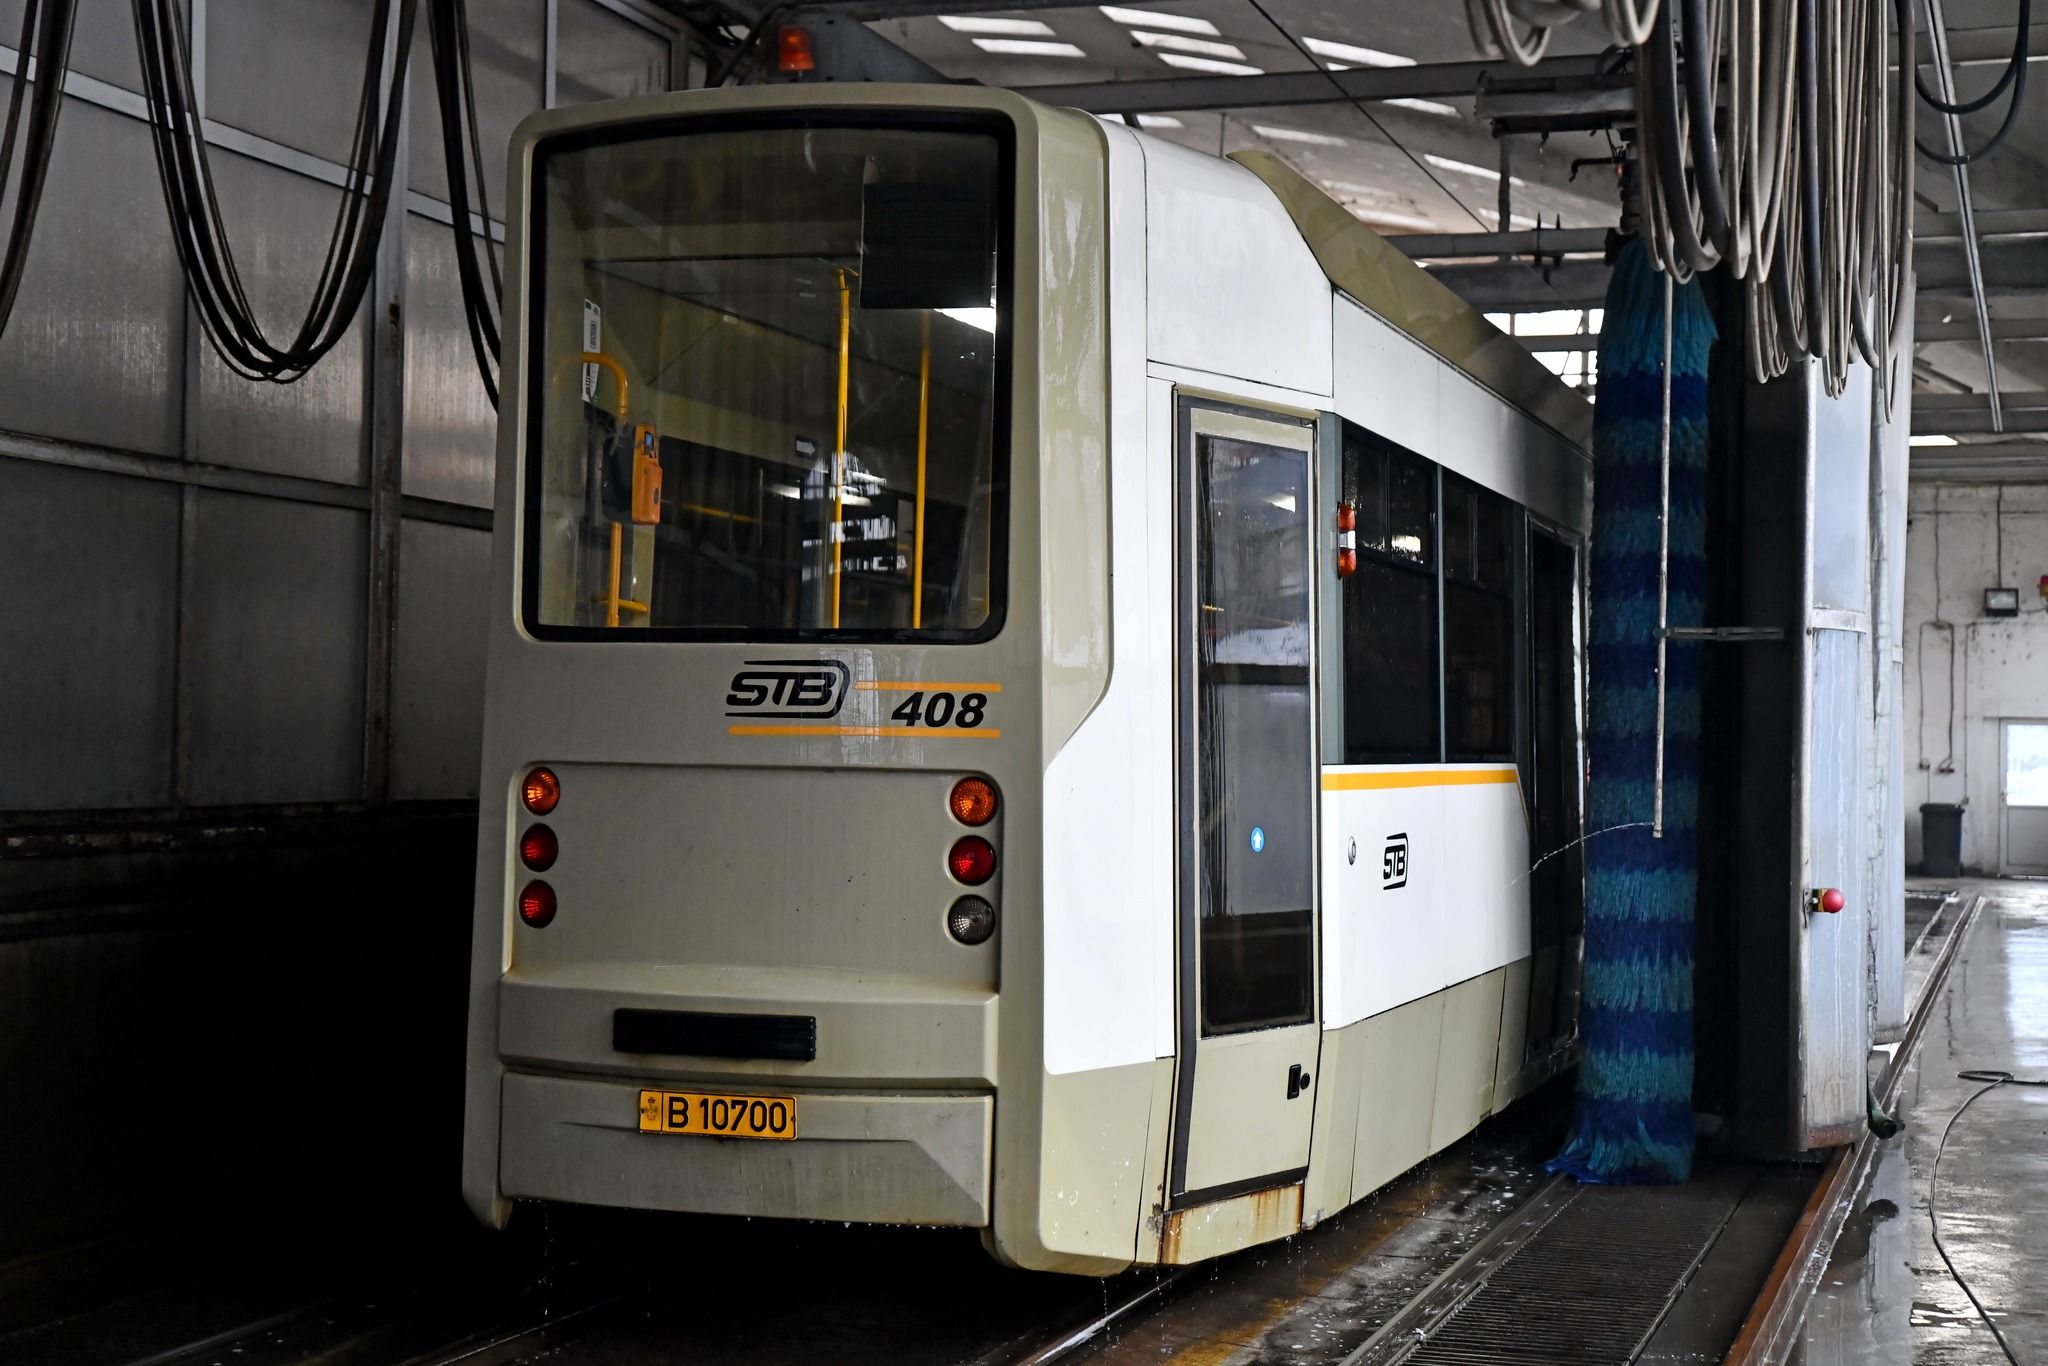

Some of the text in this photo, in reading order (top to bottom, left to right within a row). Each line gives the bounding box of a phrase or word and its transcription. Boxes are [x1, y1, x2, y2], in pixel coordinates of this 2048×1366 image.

[725, 671, 838, 707] STB
[890, 691, 988, 729] 408
[1382, 843, 1407, 880] STB
[668, 1096, 788, 1133] B 10700
